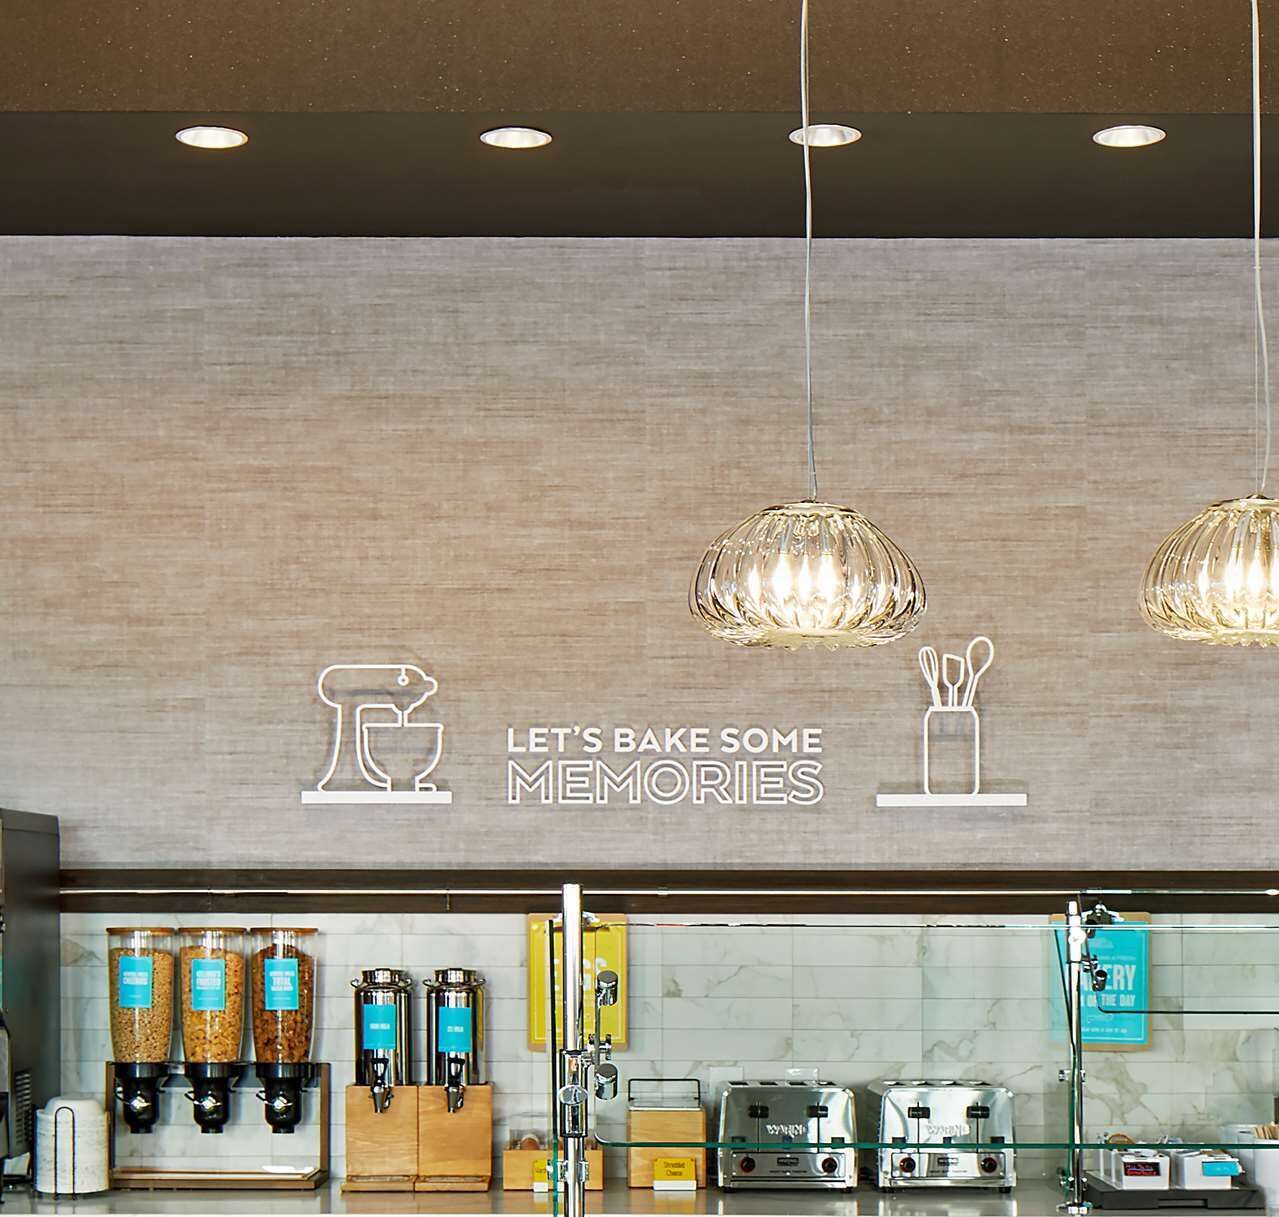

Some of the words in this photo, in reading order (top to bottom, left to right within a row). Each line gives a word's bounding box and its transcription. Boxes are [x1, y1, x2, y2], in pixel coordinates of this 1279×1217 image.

[508, 726, 603, 753] LET'S
[614, 727, 710, 753] BAKE
[720, 727, 823, 753] SOME
[507, 759, 825, 806] MEMORIES
[1101, 994, 1117, 1007] THE
[1120, 994, 1136, 1007] DAY
